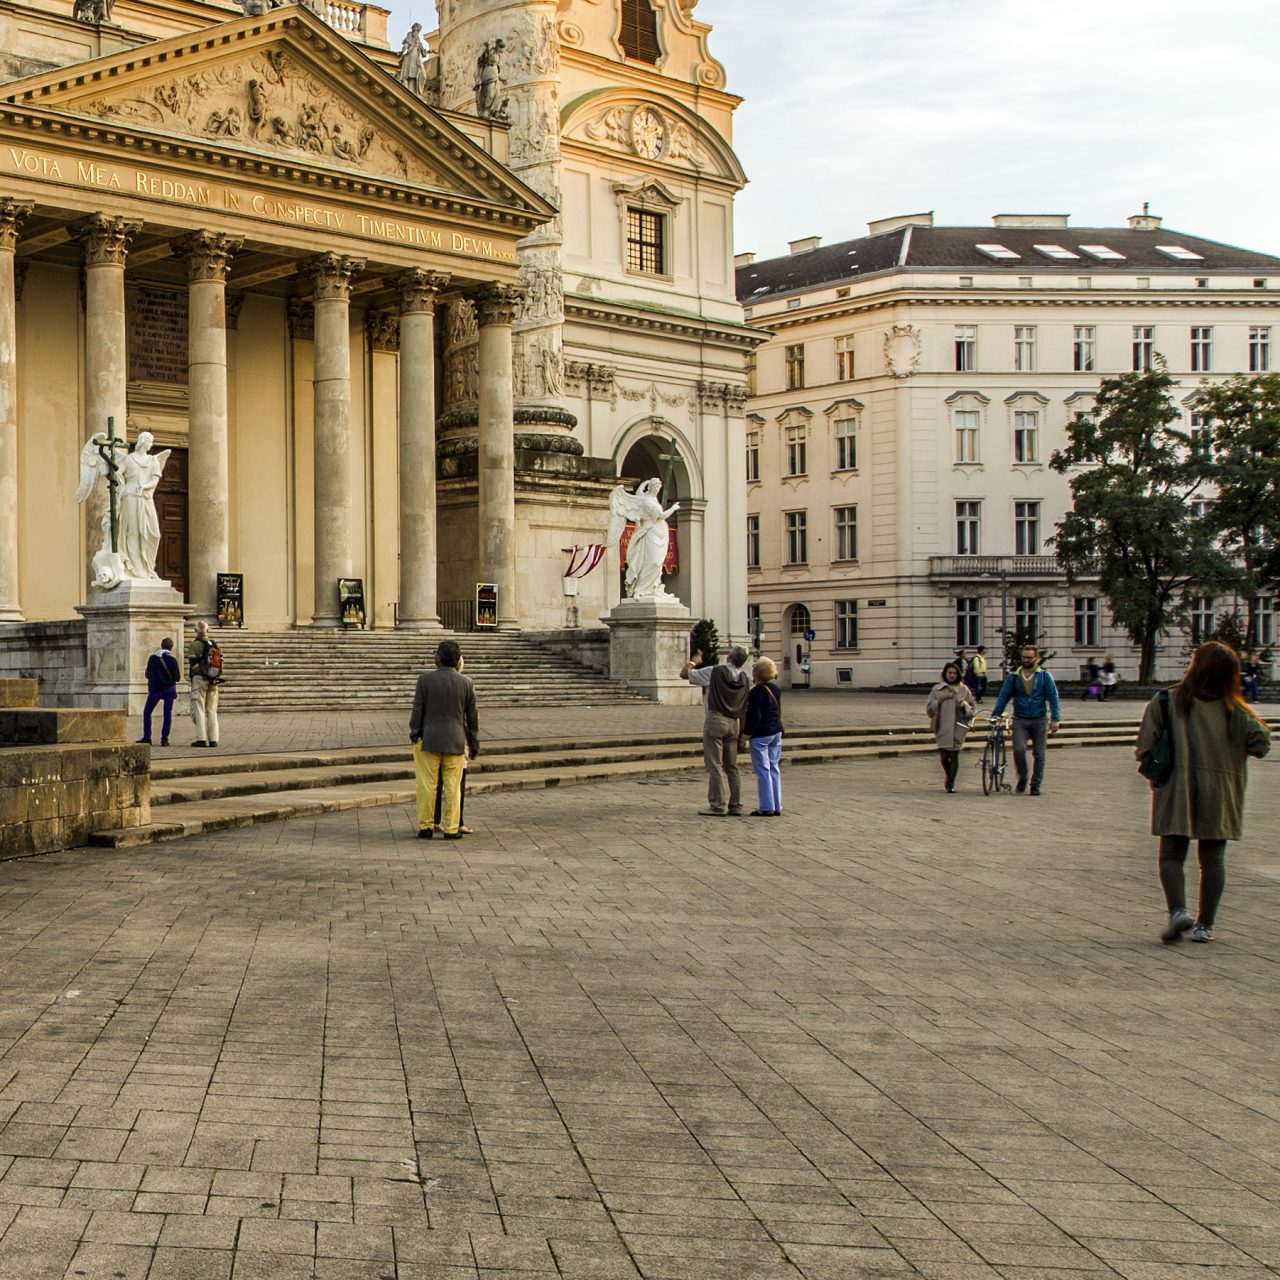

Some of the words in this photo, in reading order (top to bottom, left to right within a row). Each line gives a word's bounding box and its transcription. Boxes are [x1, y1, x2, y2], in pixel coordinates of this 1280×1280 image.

[10, 148, 62, 178] VOTA
[77, 160, 121, 188] MEA
[136, 172, 210, 205] REDDAM
[223, 188, 240, 210] IN
[357, 214, 442, 248] TIMENTIVM
[452, 232, 493, 257] DEVM
